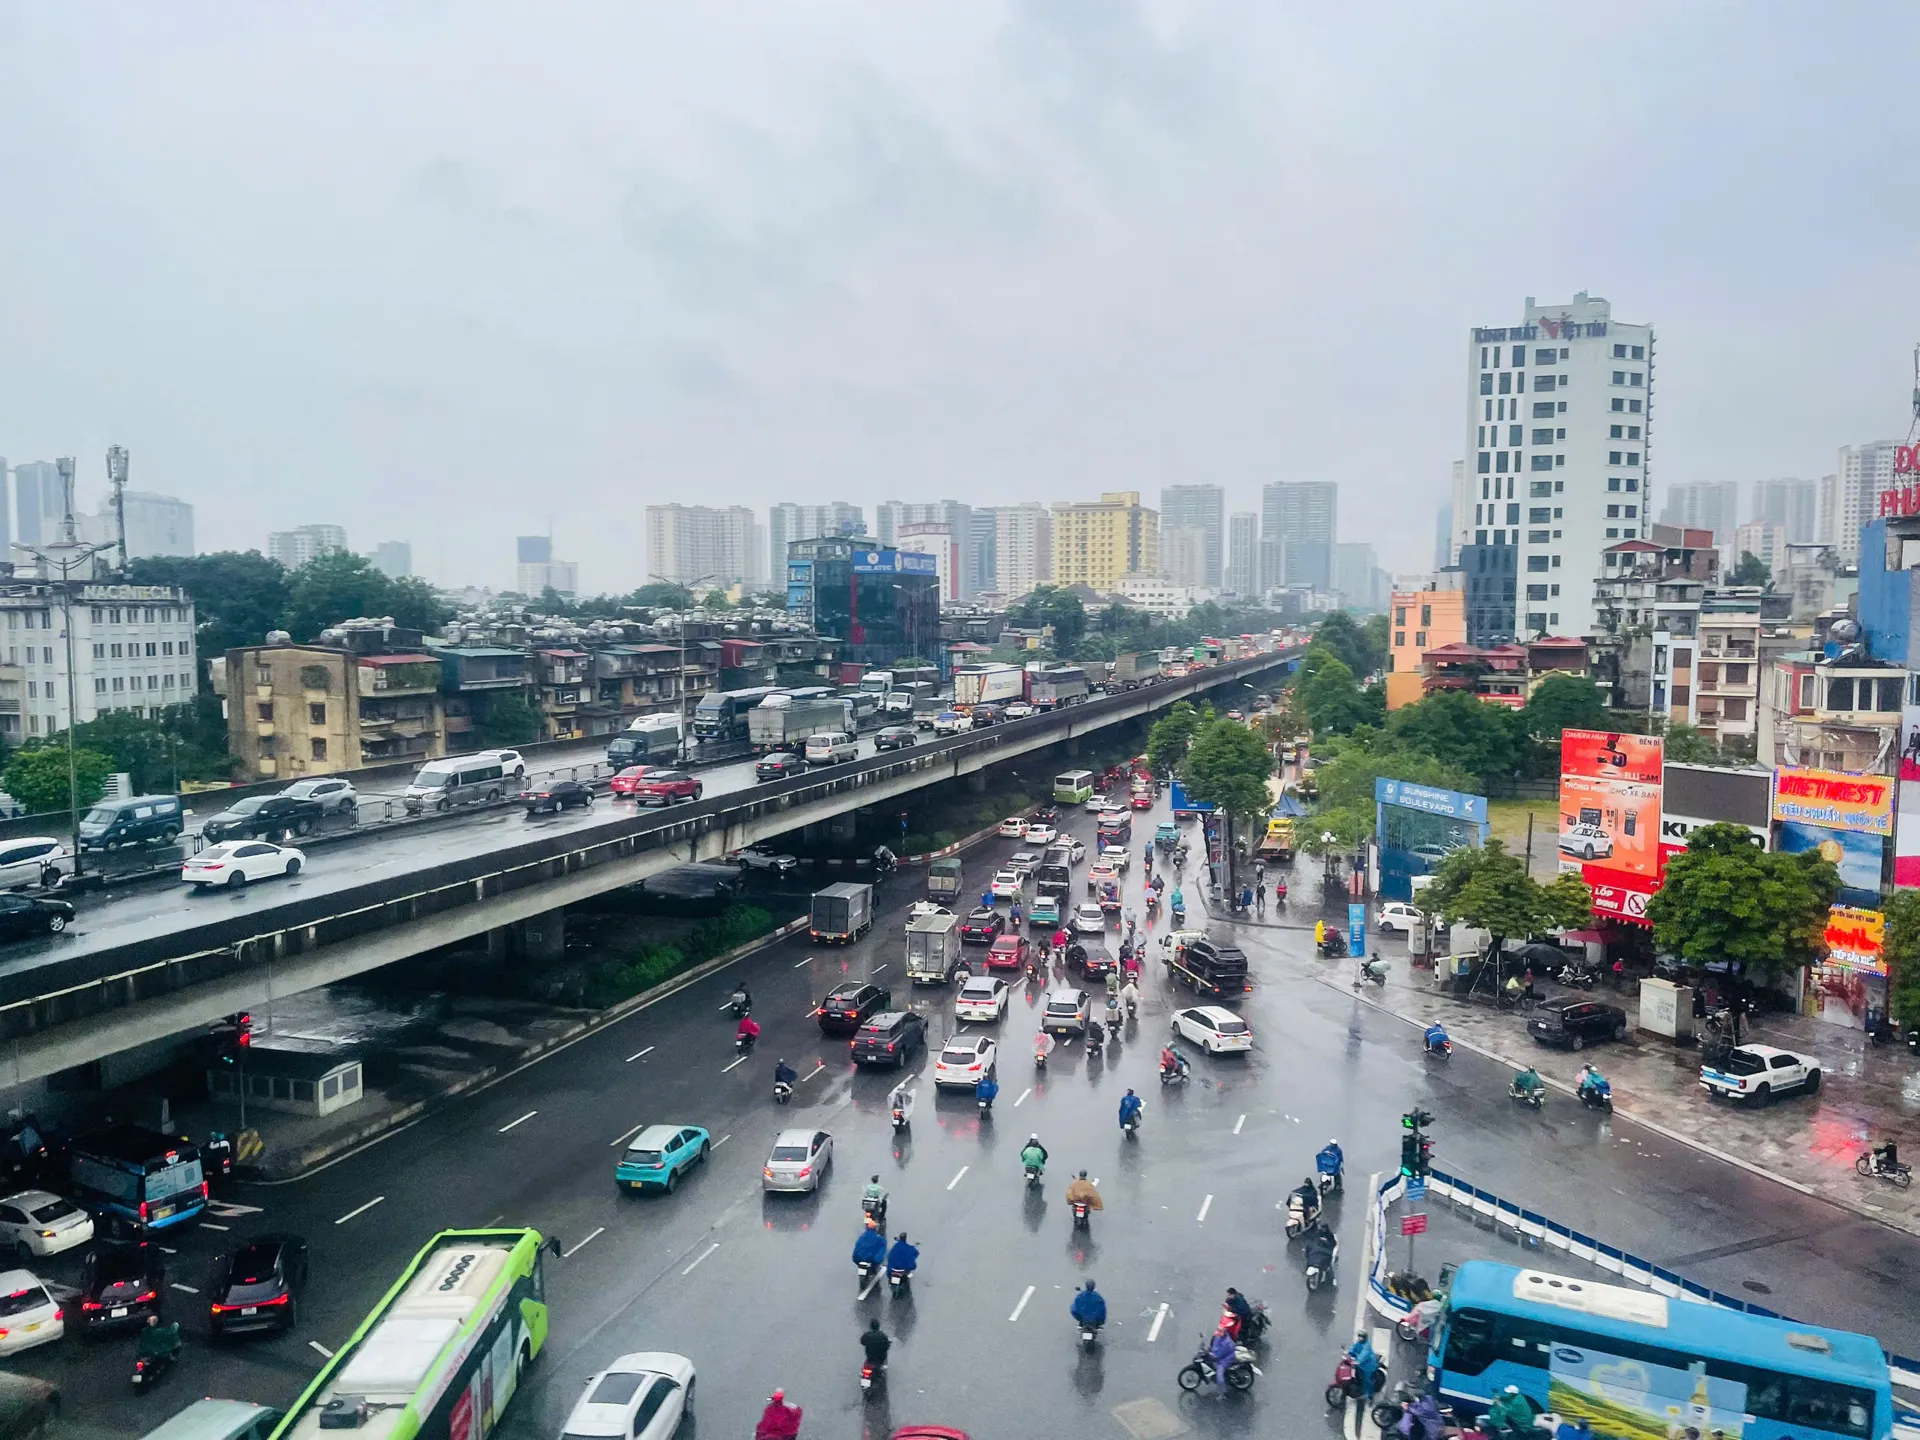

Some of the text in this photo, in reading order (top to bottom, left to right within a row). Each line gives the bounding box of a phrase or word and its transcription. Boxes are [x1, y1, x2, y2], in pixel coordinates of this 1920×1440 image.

[84, 585, 171, 600] NACENTECH
[1404, 786, 1449, 802] SUNSHINE
[1564, 781, 1590, 792] THÔNG
[1610, 787, 1629, 796] CHO
[1630, 789, 1639, 797] XE
[1399, 795, 1455, 814] BOULEVARD
[1777, 801, 1801, 817] TIÊU
[1803, 805, 1841, 822] CHUẨN
[1874, 813, 1888, 829] TẾ
